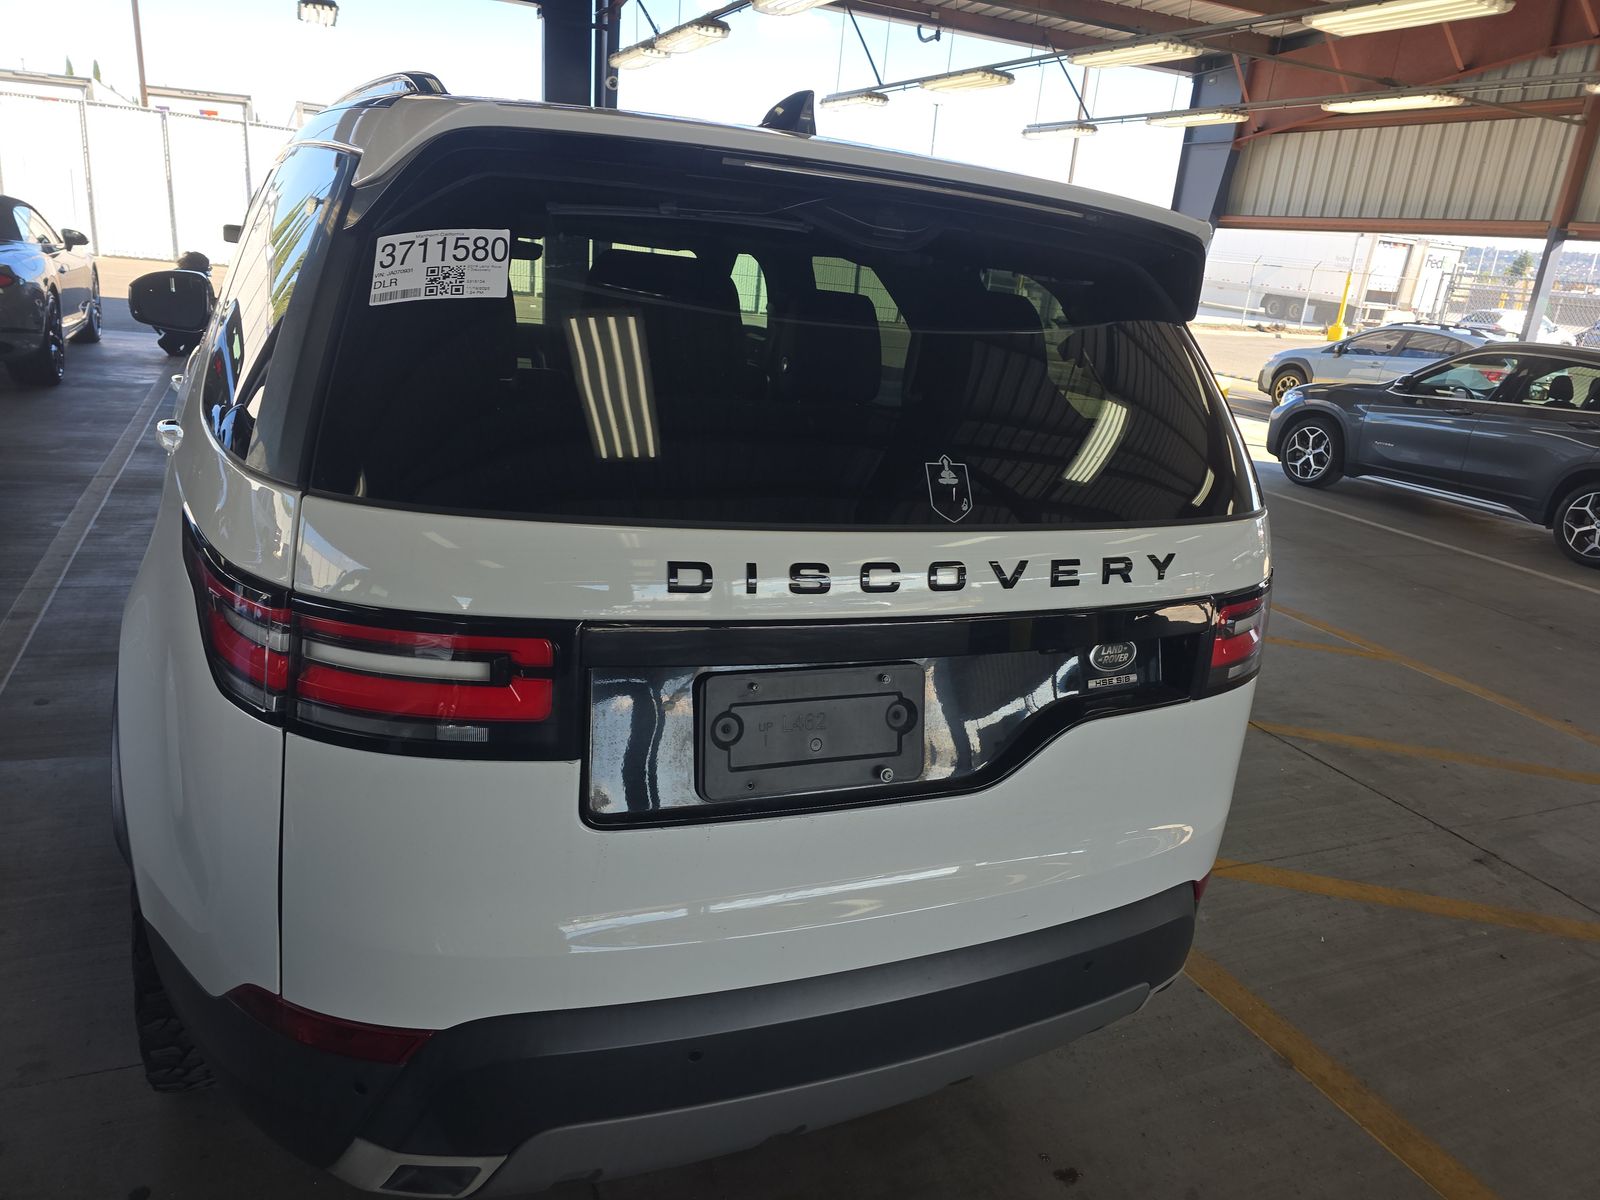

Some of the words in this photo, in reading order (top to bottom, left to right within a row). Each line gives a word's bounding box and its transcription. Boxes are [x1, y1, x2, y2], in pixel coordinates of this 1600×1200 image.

[379, 236, 509, 269] 3711580
[373, 278, 398, 290] DLR
[667, 553, 1177, 594] DISCOVERY
[1095, 678, 1114, 687] HSE
